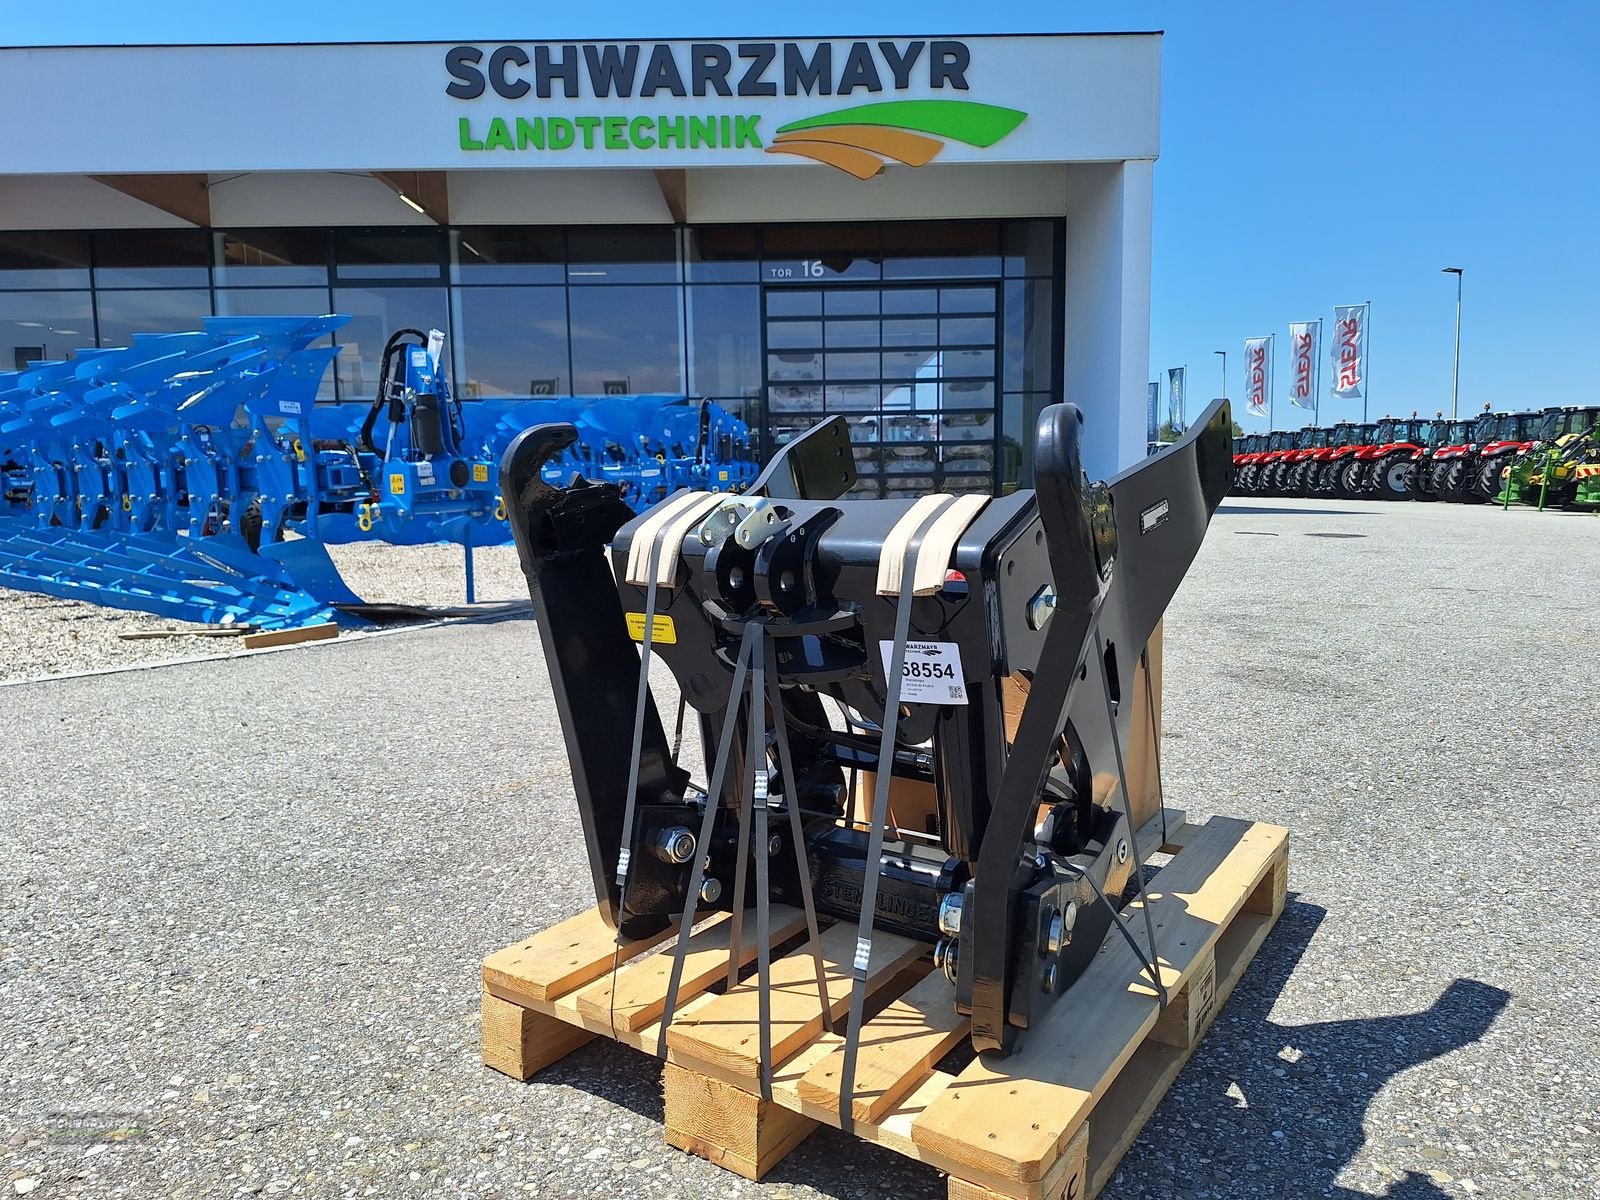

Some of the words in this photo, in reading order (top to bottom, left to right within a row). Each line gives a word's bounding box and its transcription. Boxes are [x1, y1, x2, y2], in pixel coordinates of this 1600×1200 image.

[445, 41, 971, 99] SCHWARZMAYR
[458, 115, 763, 151] LANDTECHNIK
[770, 269, 792, 278] TOR
[801, 260, 824, 277] 16
